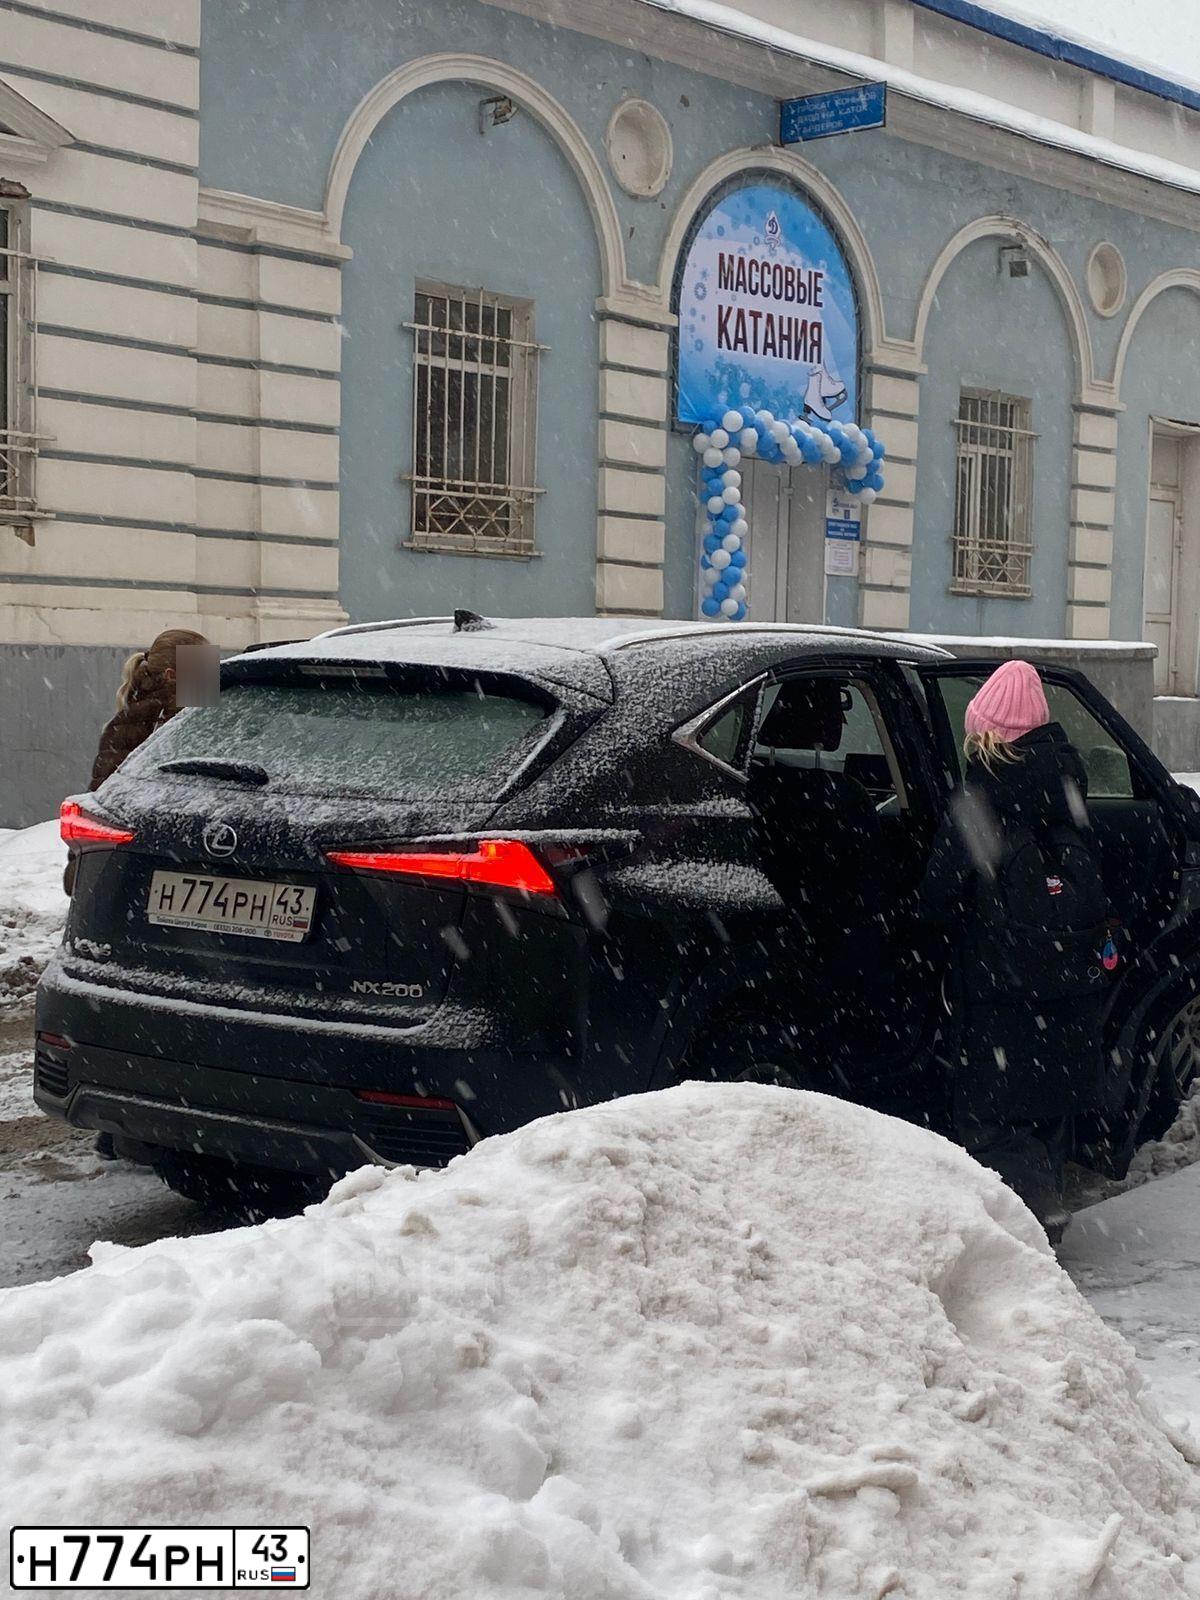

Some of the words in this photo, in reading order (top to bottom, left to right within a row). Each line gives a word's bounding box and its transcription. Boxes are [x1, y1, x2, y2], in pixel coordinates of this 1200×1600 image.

[718, 252, 824, 308] МАССОВЫЕ
[717, 304, 823, 365] КАТАНИЯ
[158, 878, 267, 922] Н774РН
[271, 915, 293, 927] RUS
[276, 887, 305, 915] 43
